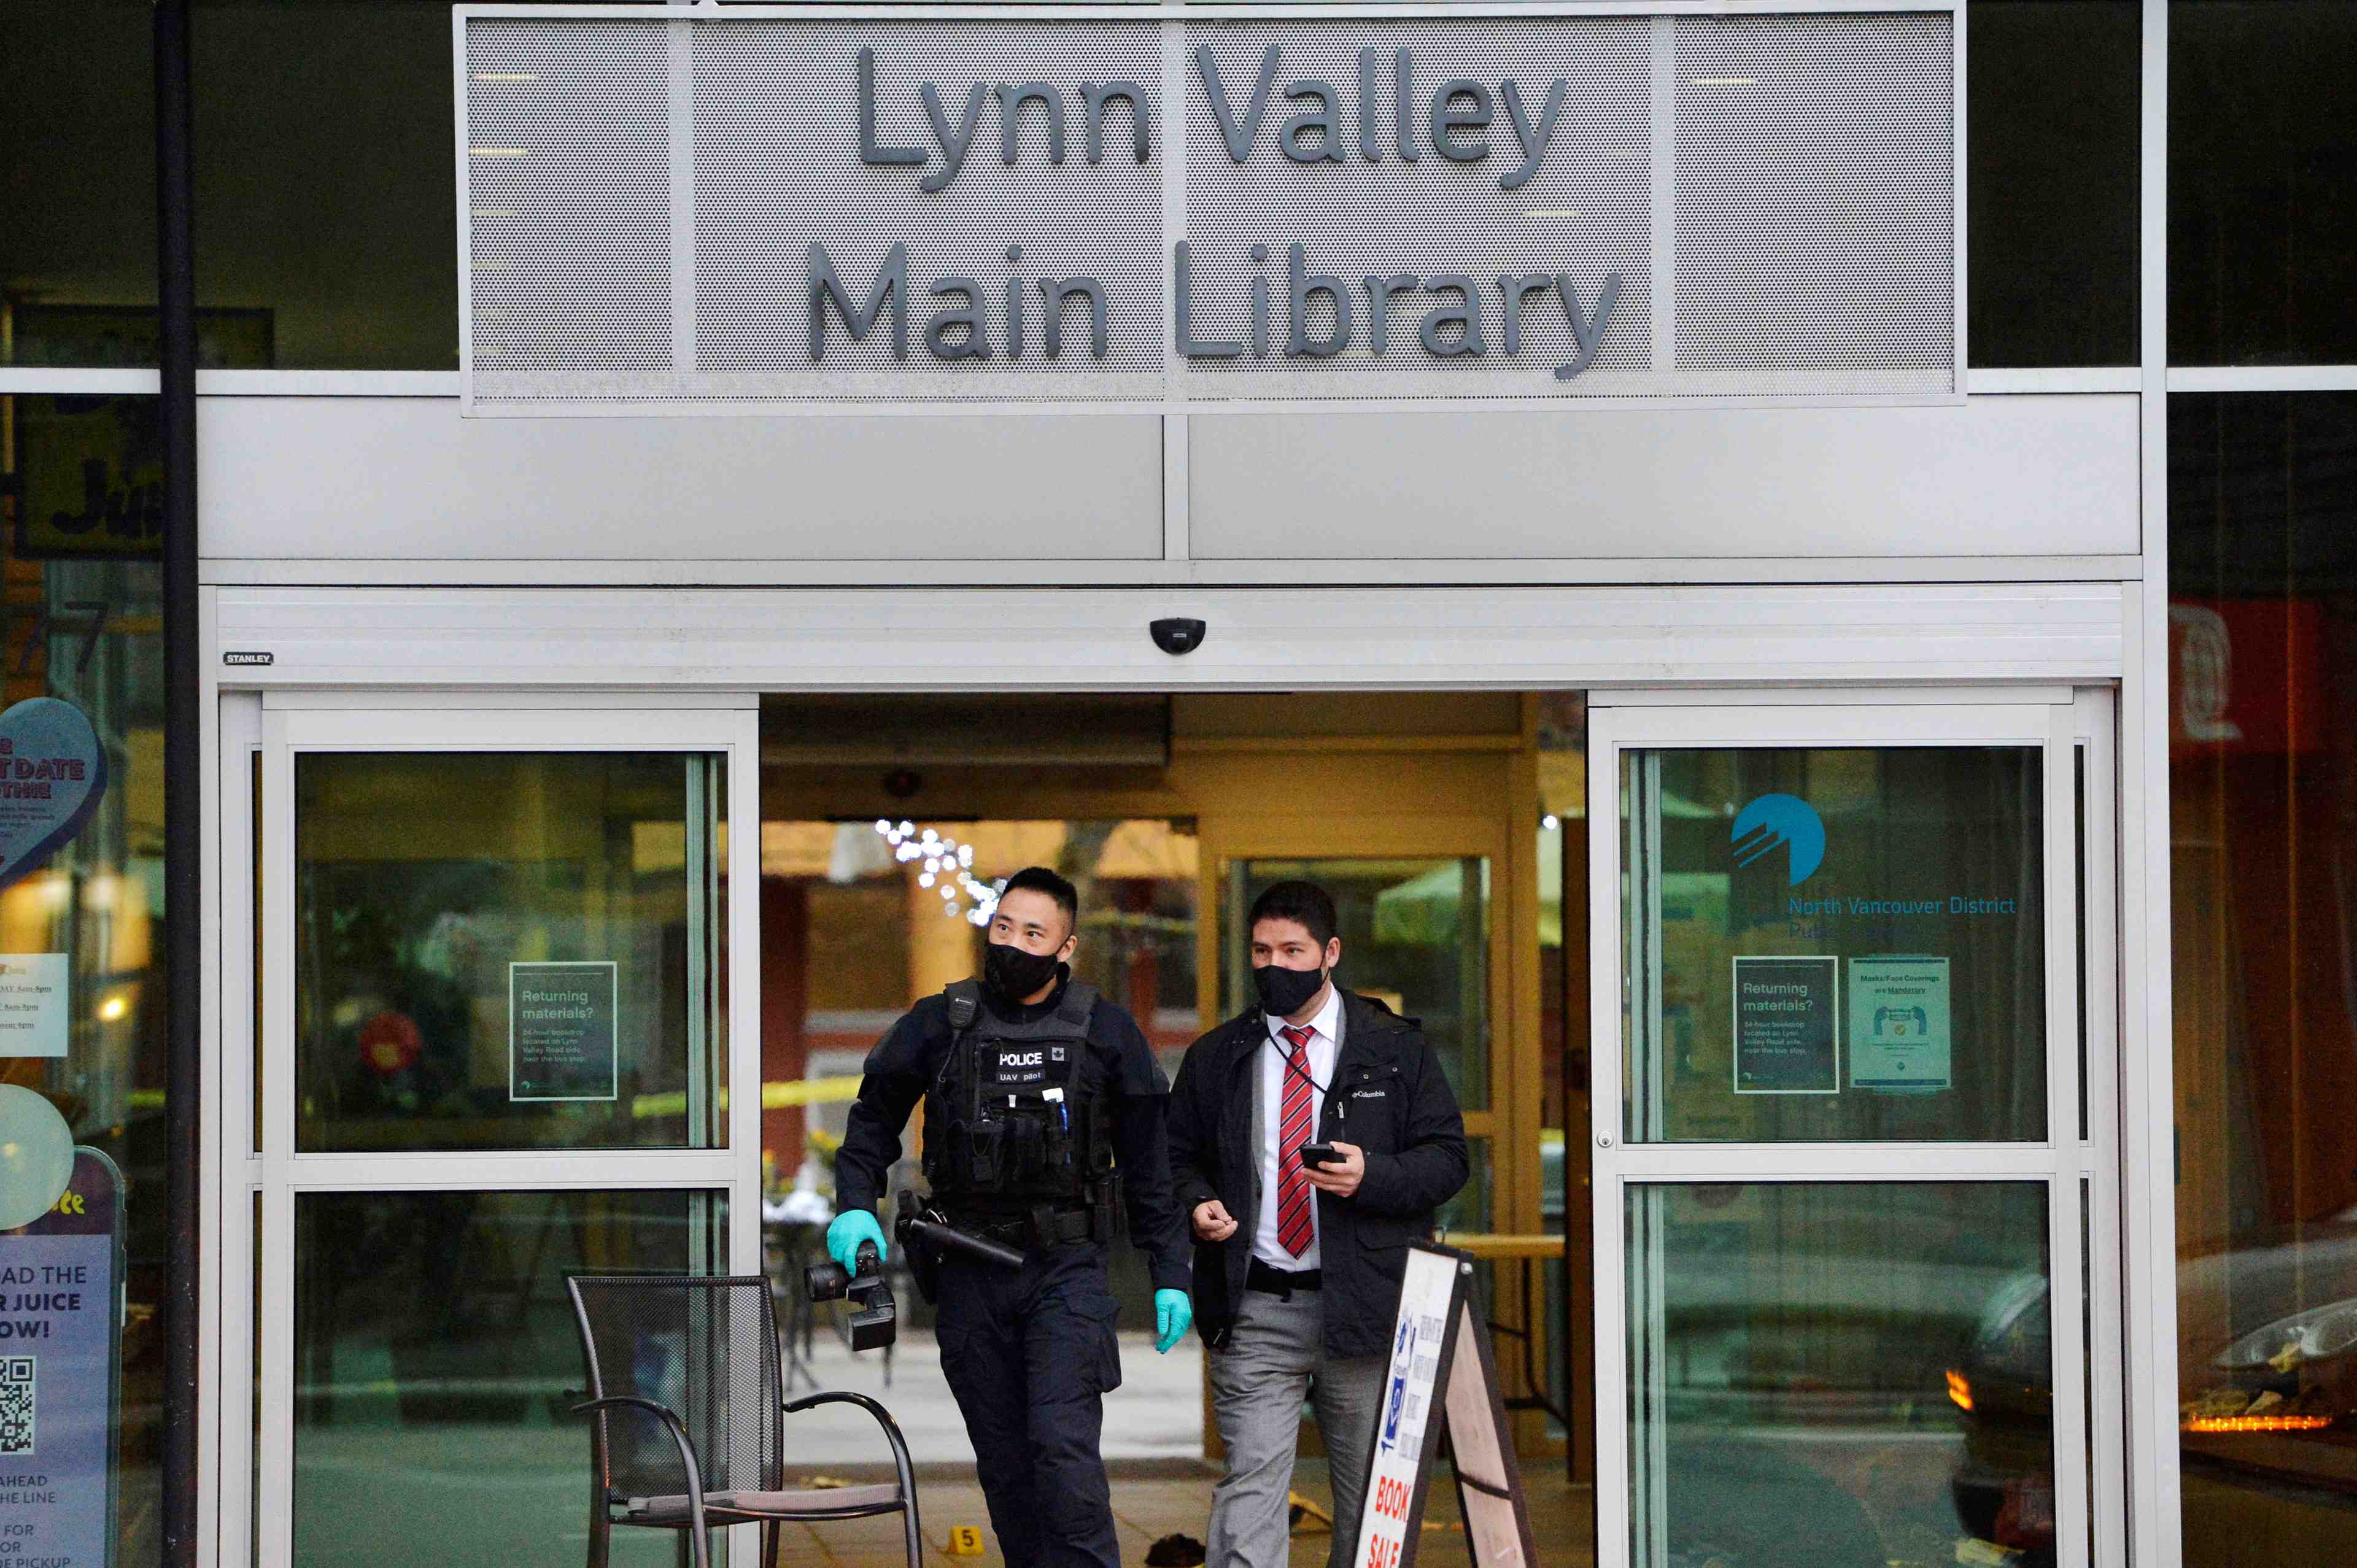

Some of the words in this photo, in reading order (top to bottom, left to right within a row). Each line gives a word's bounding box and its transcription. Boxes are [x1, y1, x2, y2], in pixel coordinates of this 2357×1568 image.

[858, 45, 1150, 193] Lynn
[1196, 44, 1569, 191] Valley
[809, 239, 1109, 360] Main
[1174, 239, 1622, 381] Library
[226, 654, 269, 663] STANLEY
[15, 758, 85, 781] DATE
[1789, 898, 1841, 914] North
[1848, 897, 1943, 914] Vancouver
[1950, 897, 2016, 914] District
[1743, 983, 1808, 997] Returning
[522, 991, 588, 1005] Returning
[1743, 1000, 1813, 1011] materials?
[522, 1007, 594, 1019] materials?
[999, 1052, 1042, 1066] POLICE
[1023, 1072, 1041, 1081] pilot
[50, 1189, 85, 1215] ce
[1, 1267, 34, 1284] AD
[41, 1266, 87, 1284] THE
[13, 1293, 80, 1311] JUICE
[0, 1321, 49, 1338] OW!
[0, 1475, 48, 1487] AHEAD
[24, 1492, 56, 1504] LINE
[1375, 1475, 1412, 1523] BOOK
[4, 1524, 34, 1535] FOR
[962, 1529, 974, 1547] 5
[0, 1542, 21, 1554] OR
[1368, 1534, 1399, 1568] SALE
[17, 1557, 71, 1568] PICKUP
